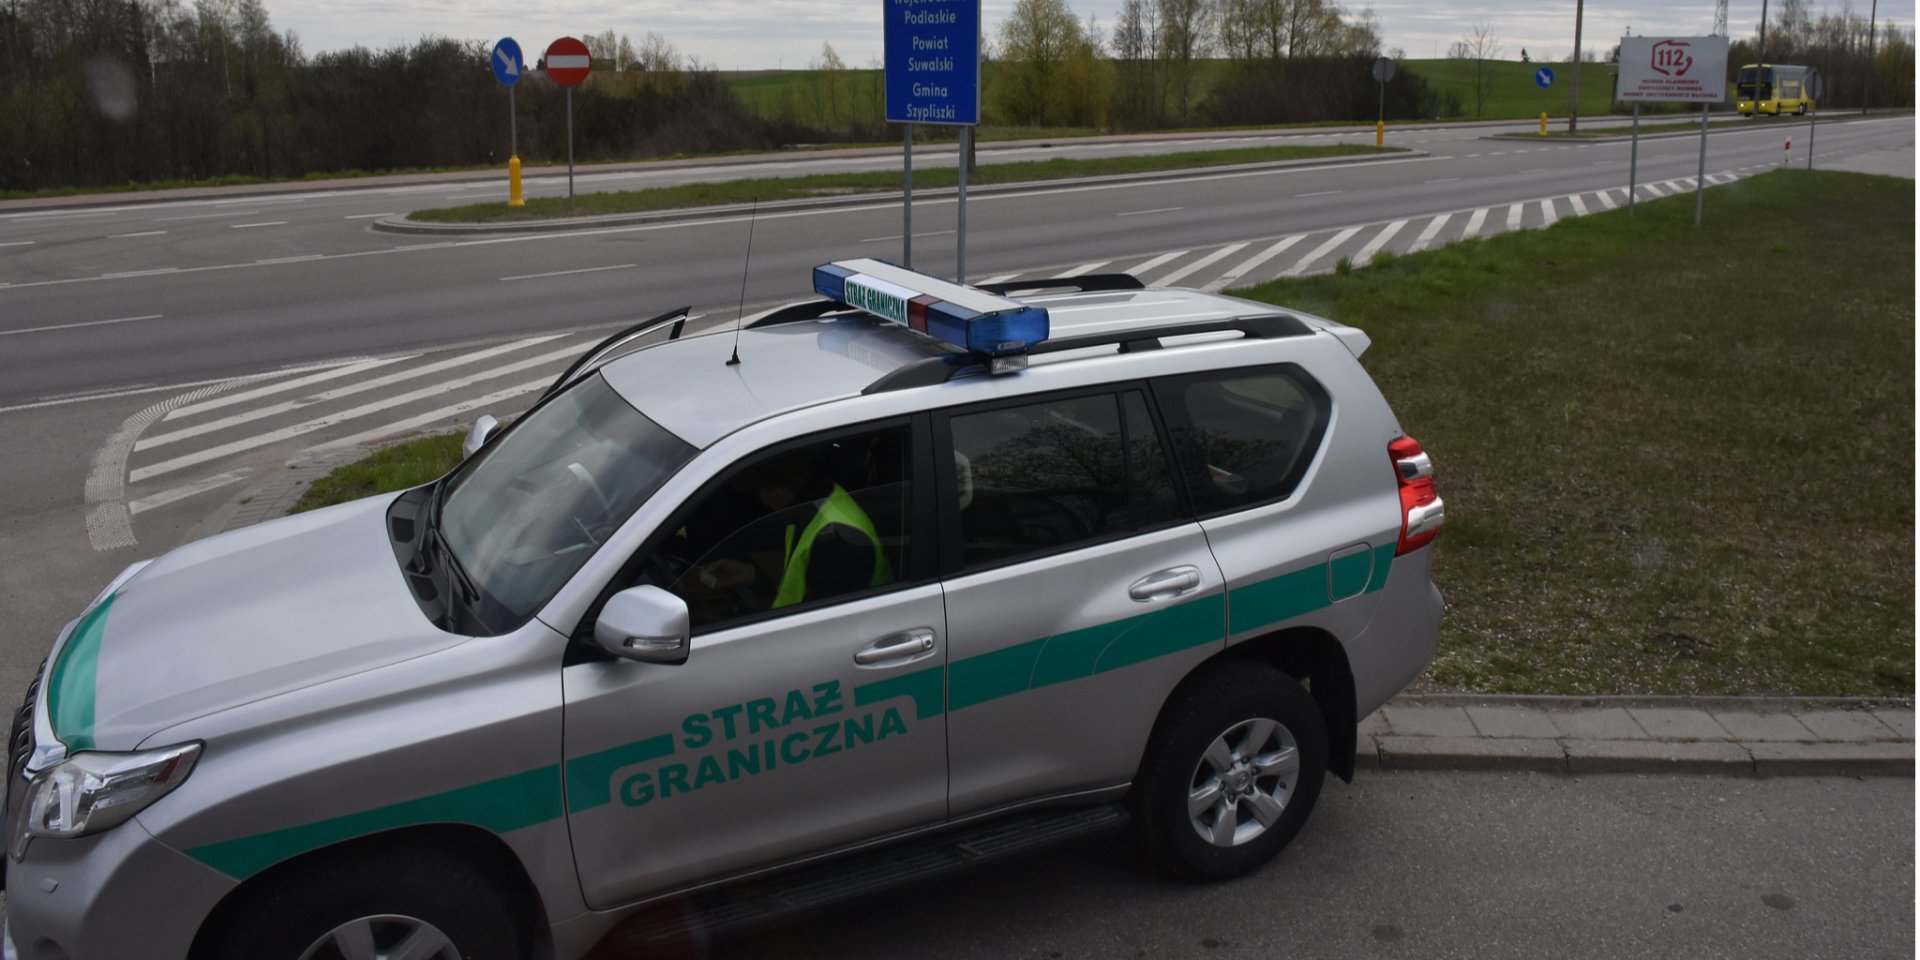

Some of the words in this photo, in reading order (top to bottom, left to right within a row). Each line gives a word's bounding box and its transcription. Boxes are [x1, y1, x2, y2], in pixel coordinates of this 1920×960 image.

[905, 10, 956, 24] Podlaskie
[912, 36, 948, 50] Powiat
[908, 57, 953, 71] Suwalski
[1658, 49, 1684, 66] 112
[912, 83, 948, 97] Gmina
[906, 104, 955, 120] Szypliszki
[867, 289, 906, 324] GRANICZNA
[620, 707, 908, 808] GRANICZNA
